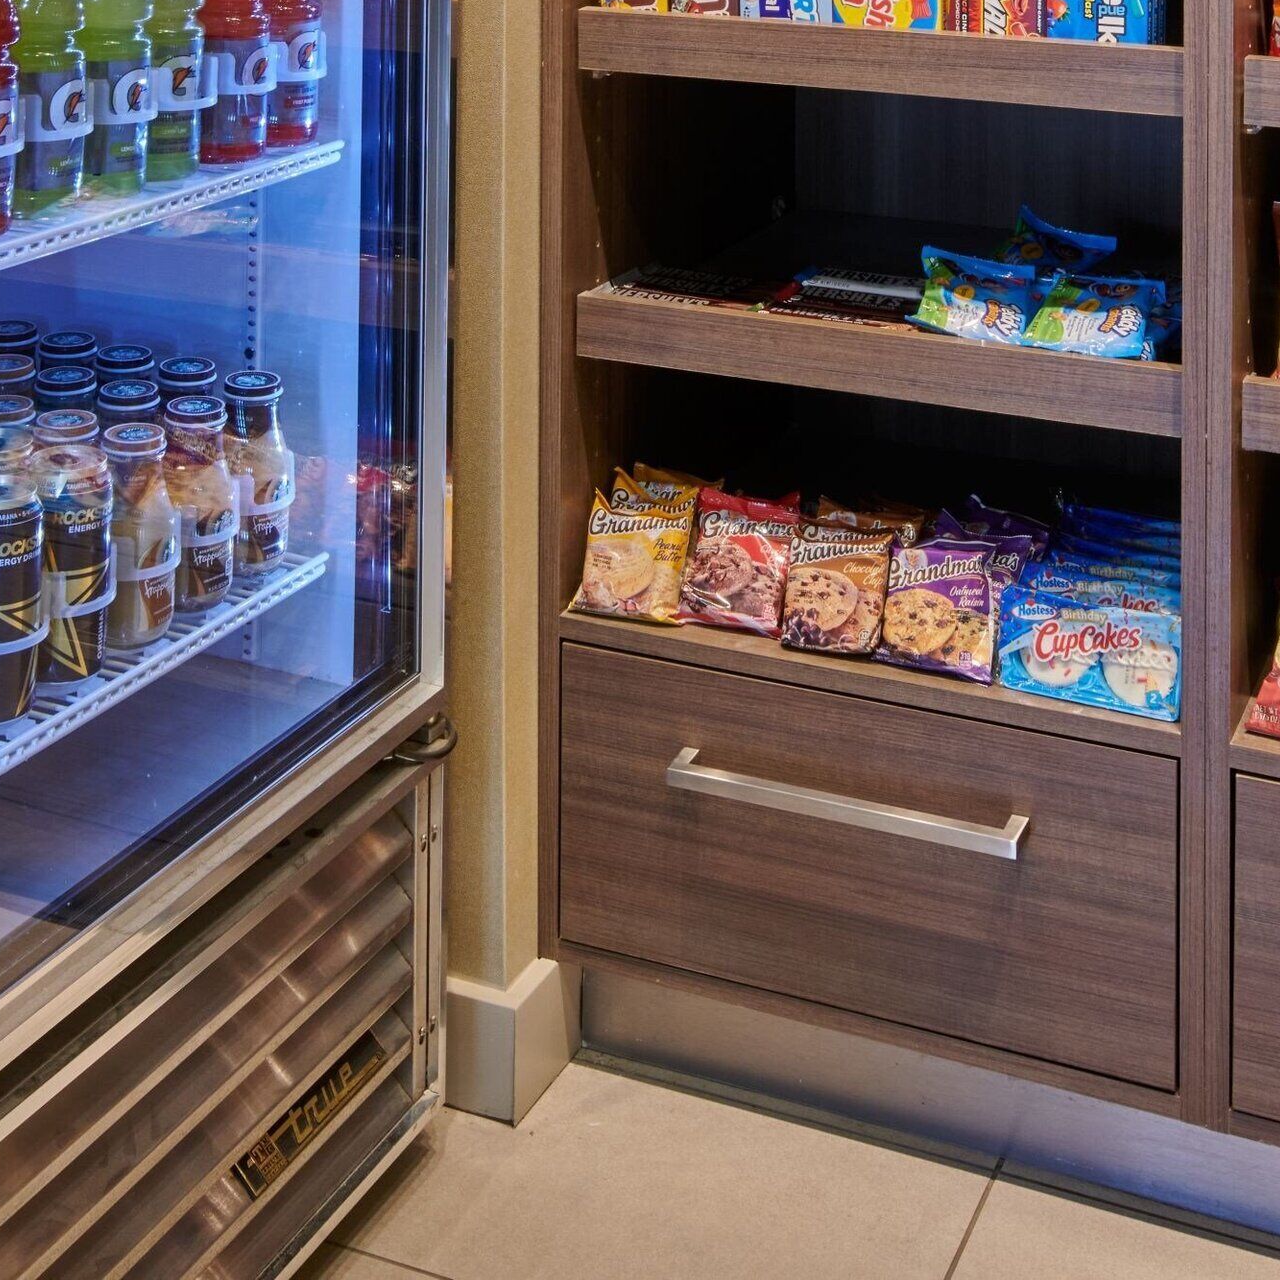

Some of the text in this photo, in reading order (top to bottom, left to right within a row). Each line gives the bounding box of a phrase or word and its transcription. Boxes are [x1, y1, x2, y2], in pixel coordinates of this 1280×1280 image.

[949, 584, 984, 597] Oatmeal
[958, 596, 984, 608] Raisin
[1018, 603, 1055, 617] Hostess
[1062, 610, 1107, 623] Birthday
